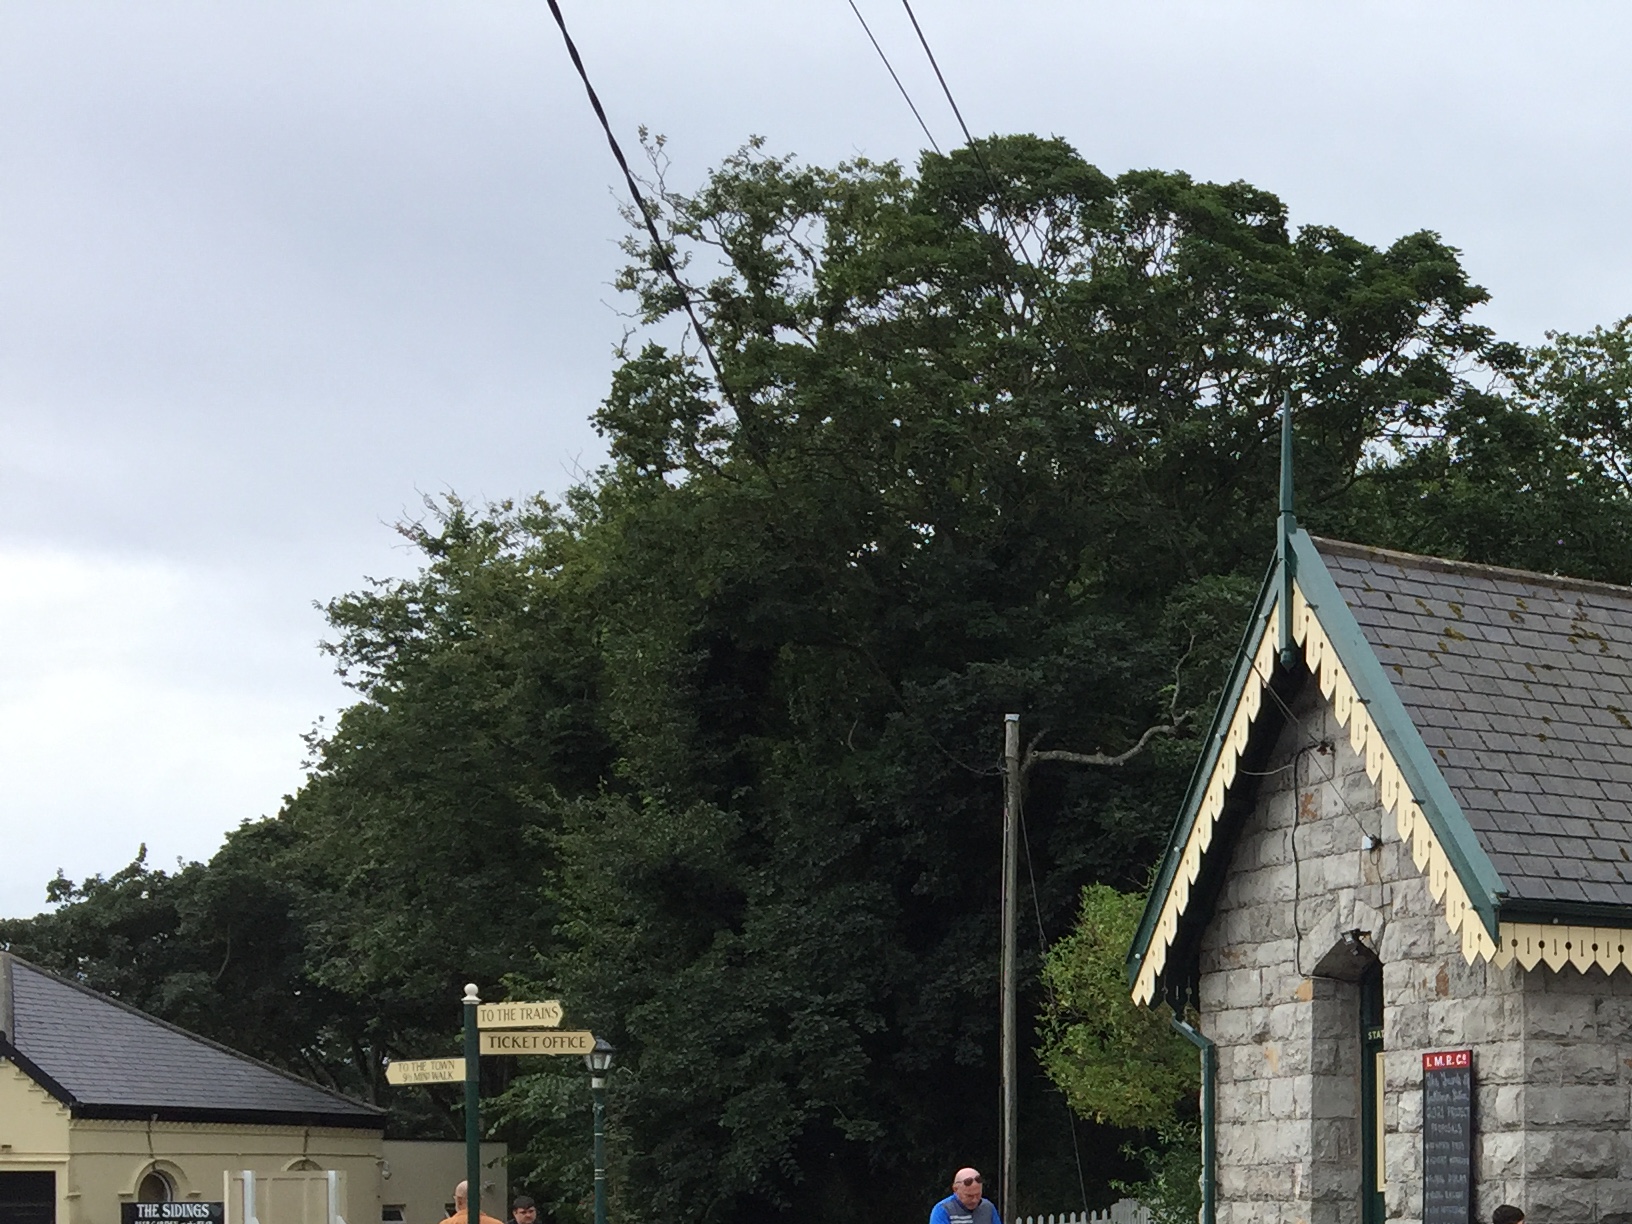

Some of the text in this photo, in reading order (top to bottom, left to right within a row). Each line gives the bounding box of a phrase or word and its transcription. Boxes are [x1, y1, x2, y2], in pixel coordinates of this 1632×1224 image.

[480, 1006, 559, 1022] TO THE TRAINS
[488, 1035, 587, 1049] TICKET OFFICE
[398, 1060, 455, 1073] TO THE TOWN
[431, 1070, 454, 1081] WALK
[136, 1203, 210, 1218] THE SIDINGS
